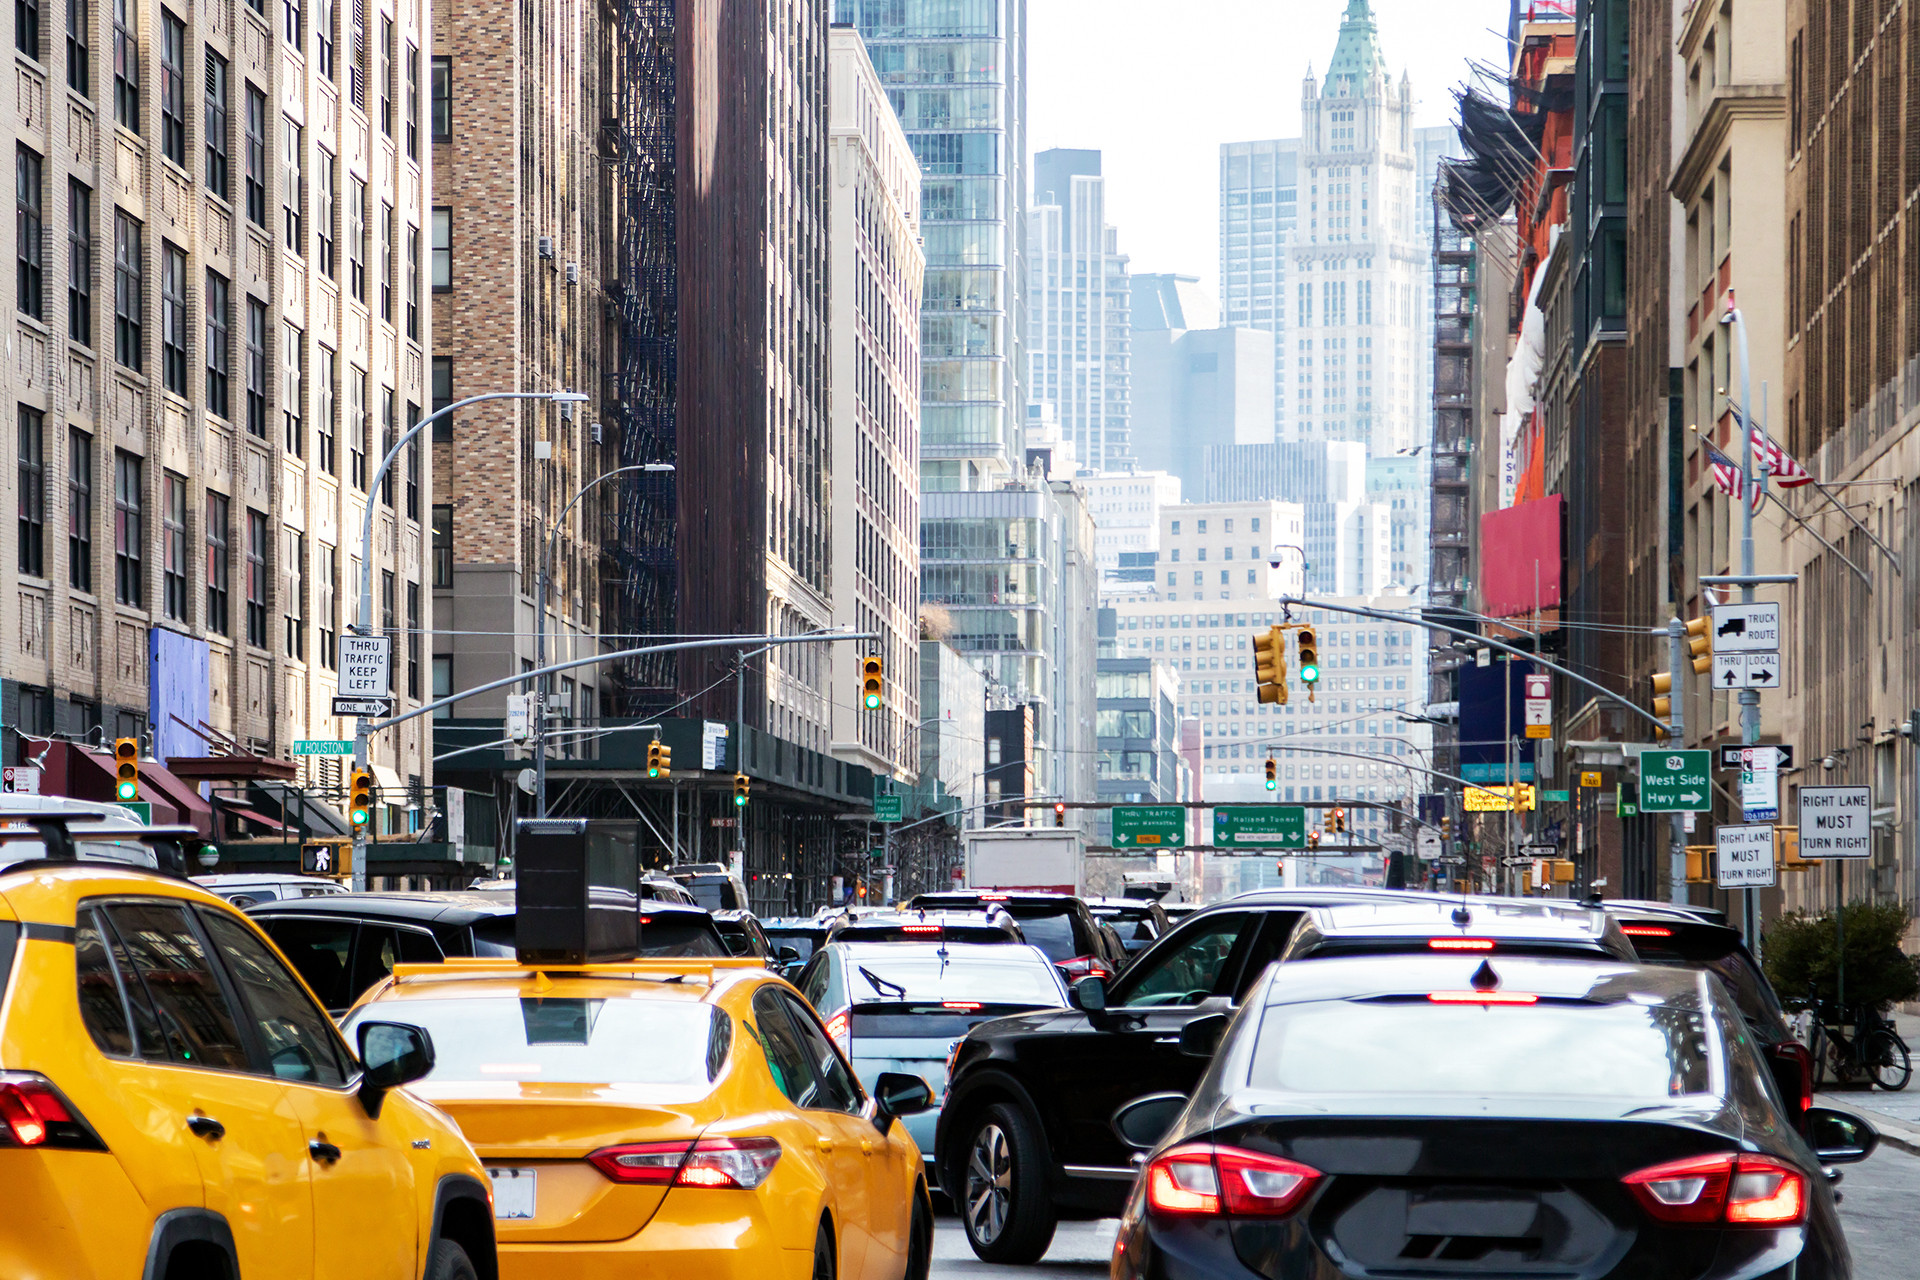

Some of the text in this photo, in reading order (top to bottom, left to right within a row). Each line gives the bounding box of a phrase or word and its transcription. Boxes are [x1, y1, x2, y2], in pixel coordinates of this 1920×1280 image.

[1748, 614, 1776, 623] TRUCK
[1748, 630, 1776, 640] ROUTE
[350, 641, 379, 651] THRU
[345, 653, 384, 665] TRAFFIC
[1720, 656, 1742, 665] THRU
[1749, 656, 1776, 665] LOCAL
[349, 667, 377, 677] KEEP
[349, 679, 376, 689] LEFT
[340, 703, 383, 713] ONE WAY
[295, 742, 302, 753] W
[305, 742, 344, 754] HOUSTON
[1668, 758, 1683, 768] 9A
[1645, 774, 1706, 786] West Side
[1647, 793, 1675, 806] Hwy
[1803, 796, 1867, 807] RIGHT LANE
[1623, 805, 1636, 814] TD
[1817, 816, 1853, 829] MUST
[1720, 832, 1770, 844] RIGHT LANE
[1803, 837, 1868, 849] TURN RIGHT
[1731, 850, 1760, 862] MUST
[1721, 868, 1772, 880] TURN RIGHT
